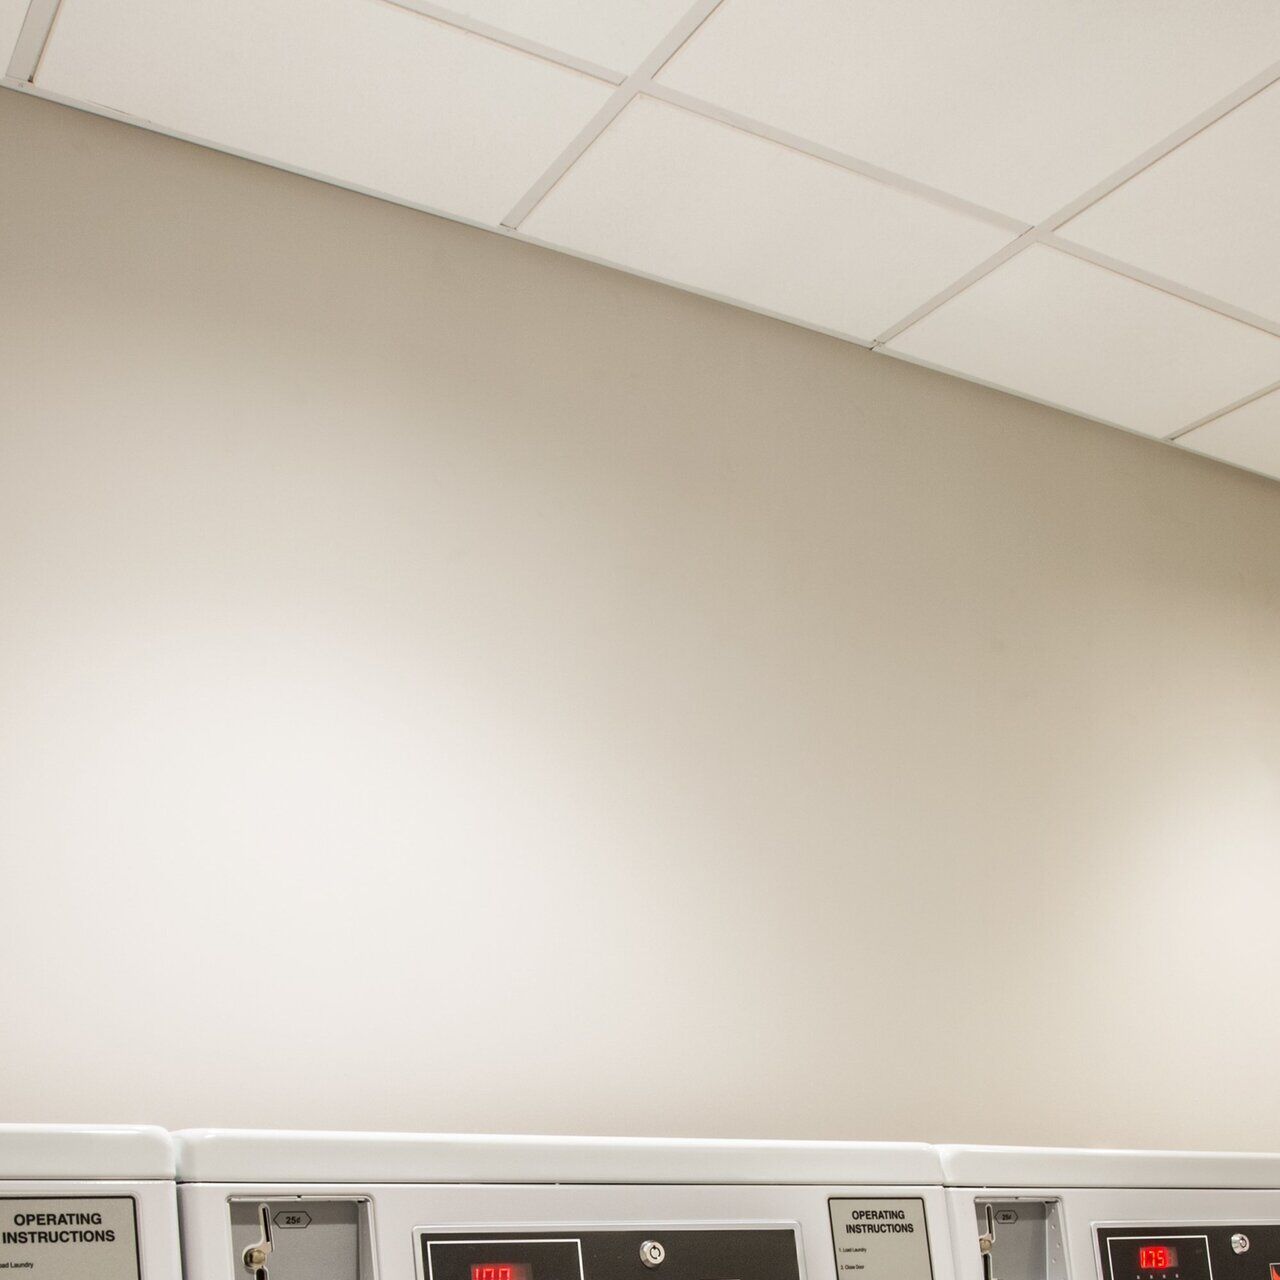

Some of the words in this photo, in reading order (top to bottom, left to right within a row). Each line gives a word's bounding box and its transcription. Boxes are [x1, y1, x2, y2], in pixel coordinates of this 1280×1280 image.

[14, 1213, 102, 1226] OPERATING
[286, 1216, 301, 1224] 25¢
[852, 1210, 905, 1220] OPERATING
[846, 1223, 914, 1233] INSTRUCTIONS
[2, 1230, 115, 1244] INSTRUCTIONS
